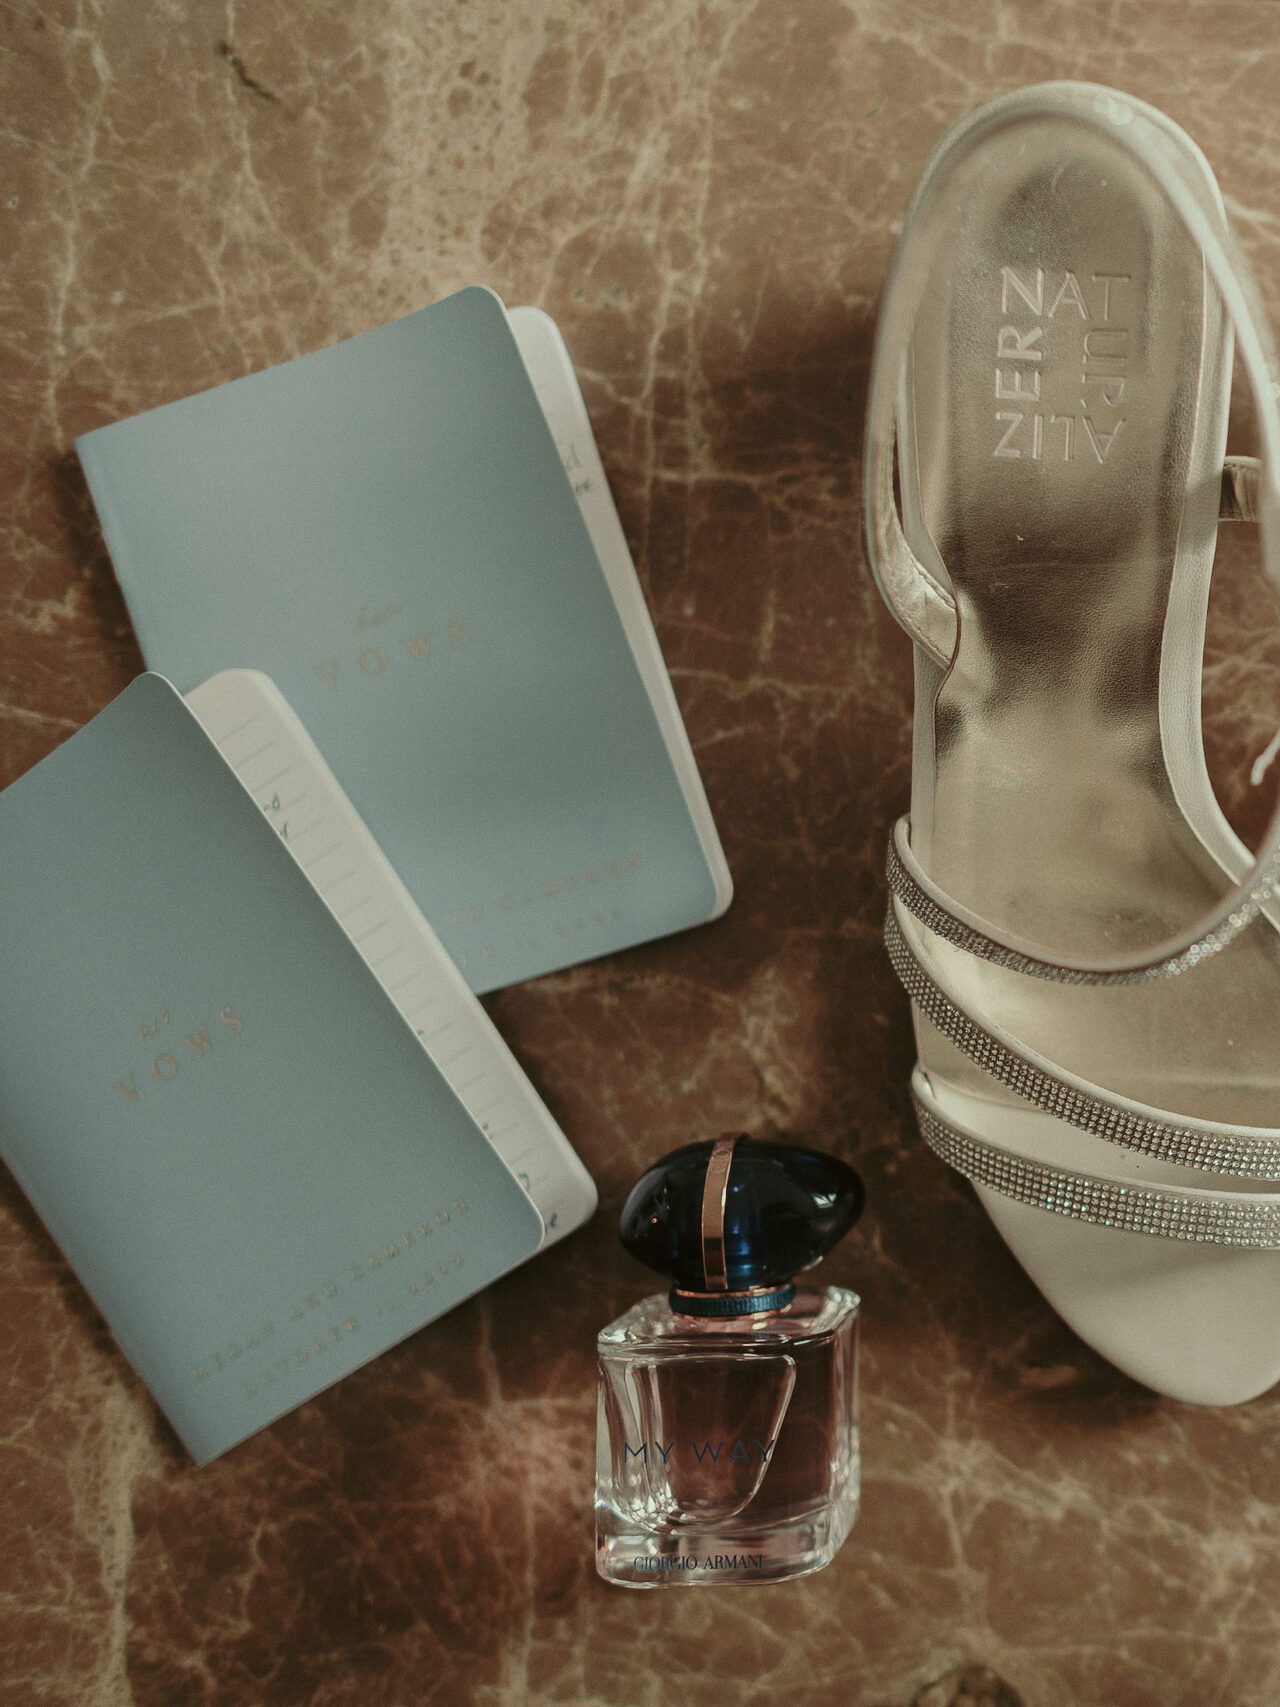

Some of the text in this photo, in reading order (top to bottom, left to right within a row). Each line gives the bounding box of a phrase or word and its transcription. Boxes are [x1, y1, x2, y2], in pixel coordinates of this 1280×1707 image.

[312, 614, 472, 690] VOWS
[112, 1002, 243, 1101] VOWS
[623, 1438, 776, 1465] MY WAY
[633, 1553, 764, 1571] GIORGIO ARMANI
